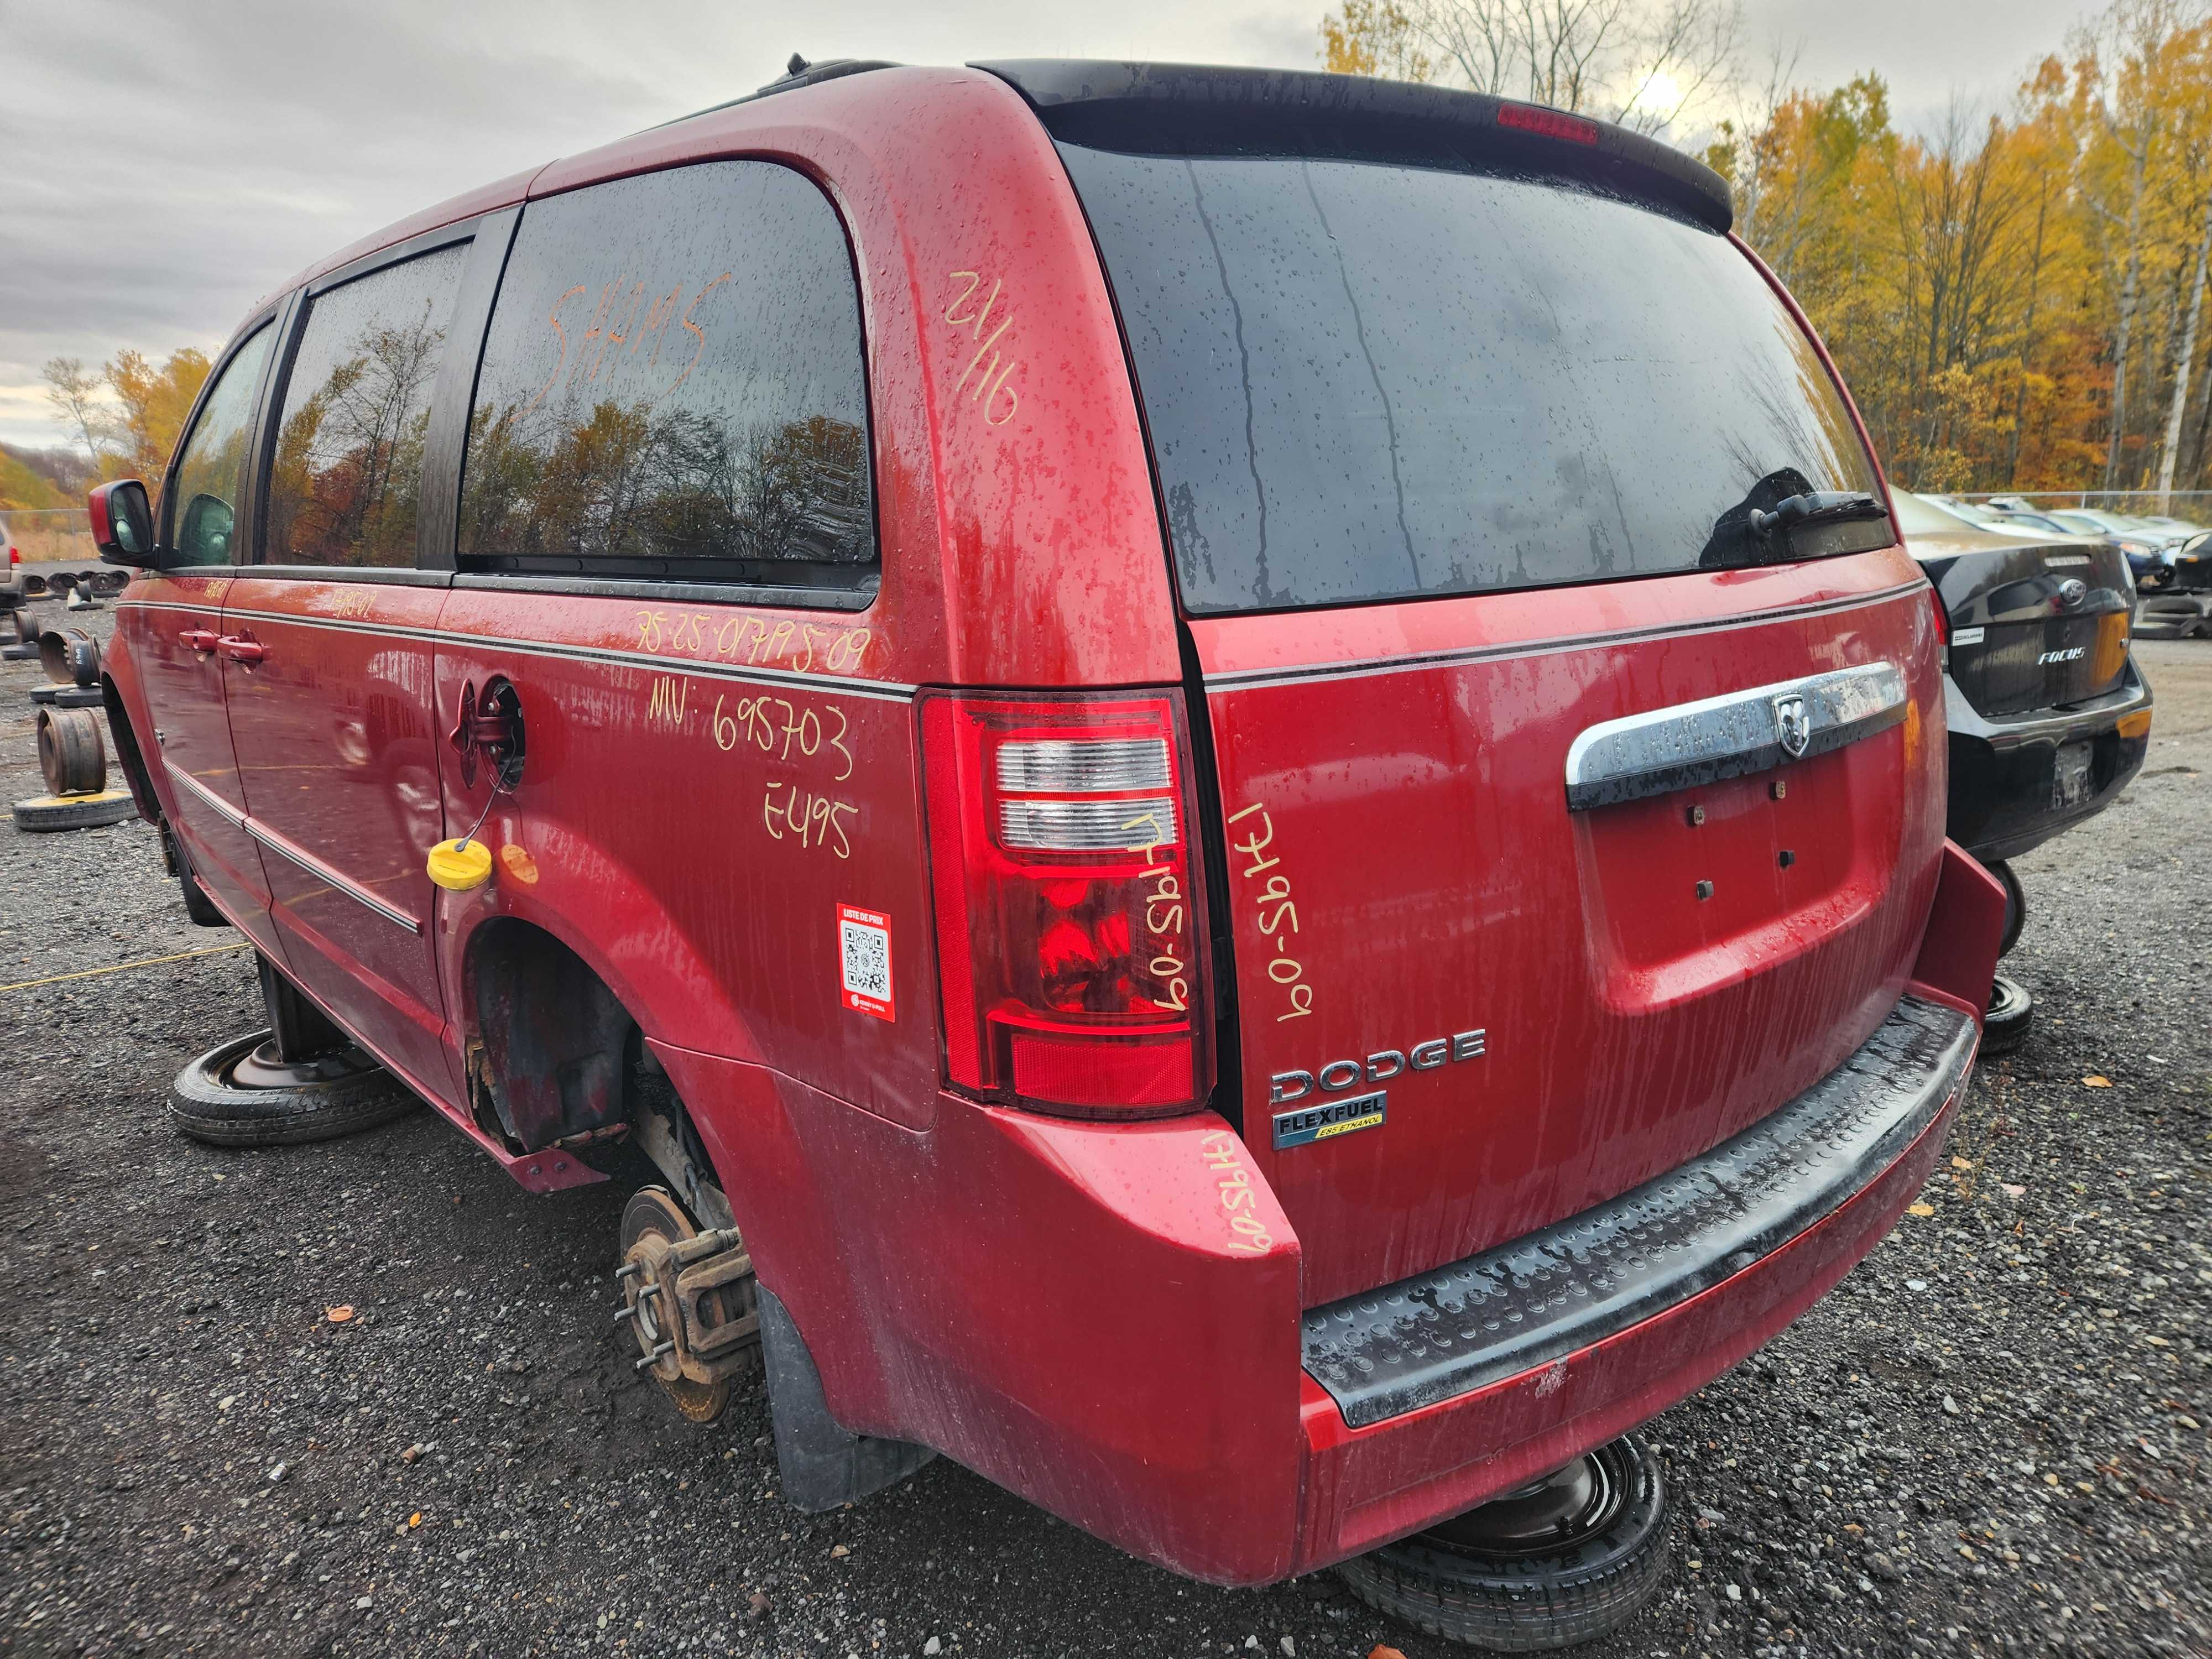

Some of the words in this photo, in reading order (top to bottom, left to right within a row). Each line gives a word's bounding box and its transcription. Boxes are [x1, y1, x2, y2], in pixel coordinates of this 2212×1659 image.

[2038, 646, 2086, 665] FOCUS
[714, 694, 853, 781] 695703
[764, 782, 859, 859] E495
[843, 907, 860, 920] LISTE
[859, 912, 869, 922] DE
[869, 914, 884, 926] PRIX
[1271, 1028, 1486, 1103] DODGE
[1320, 1125, 1337, 1136] E85
[1339, 1117, 1380, 1131] ETHANOL
